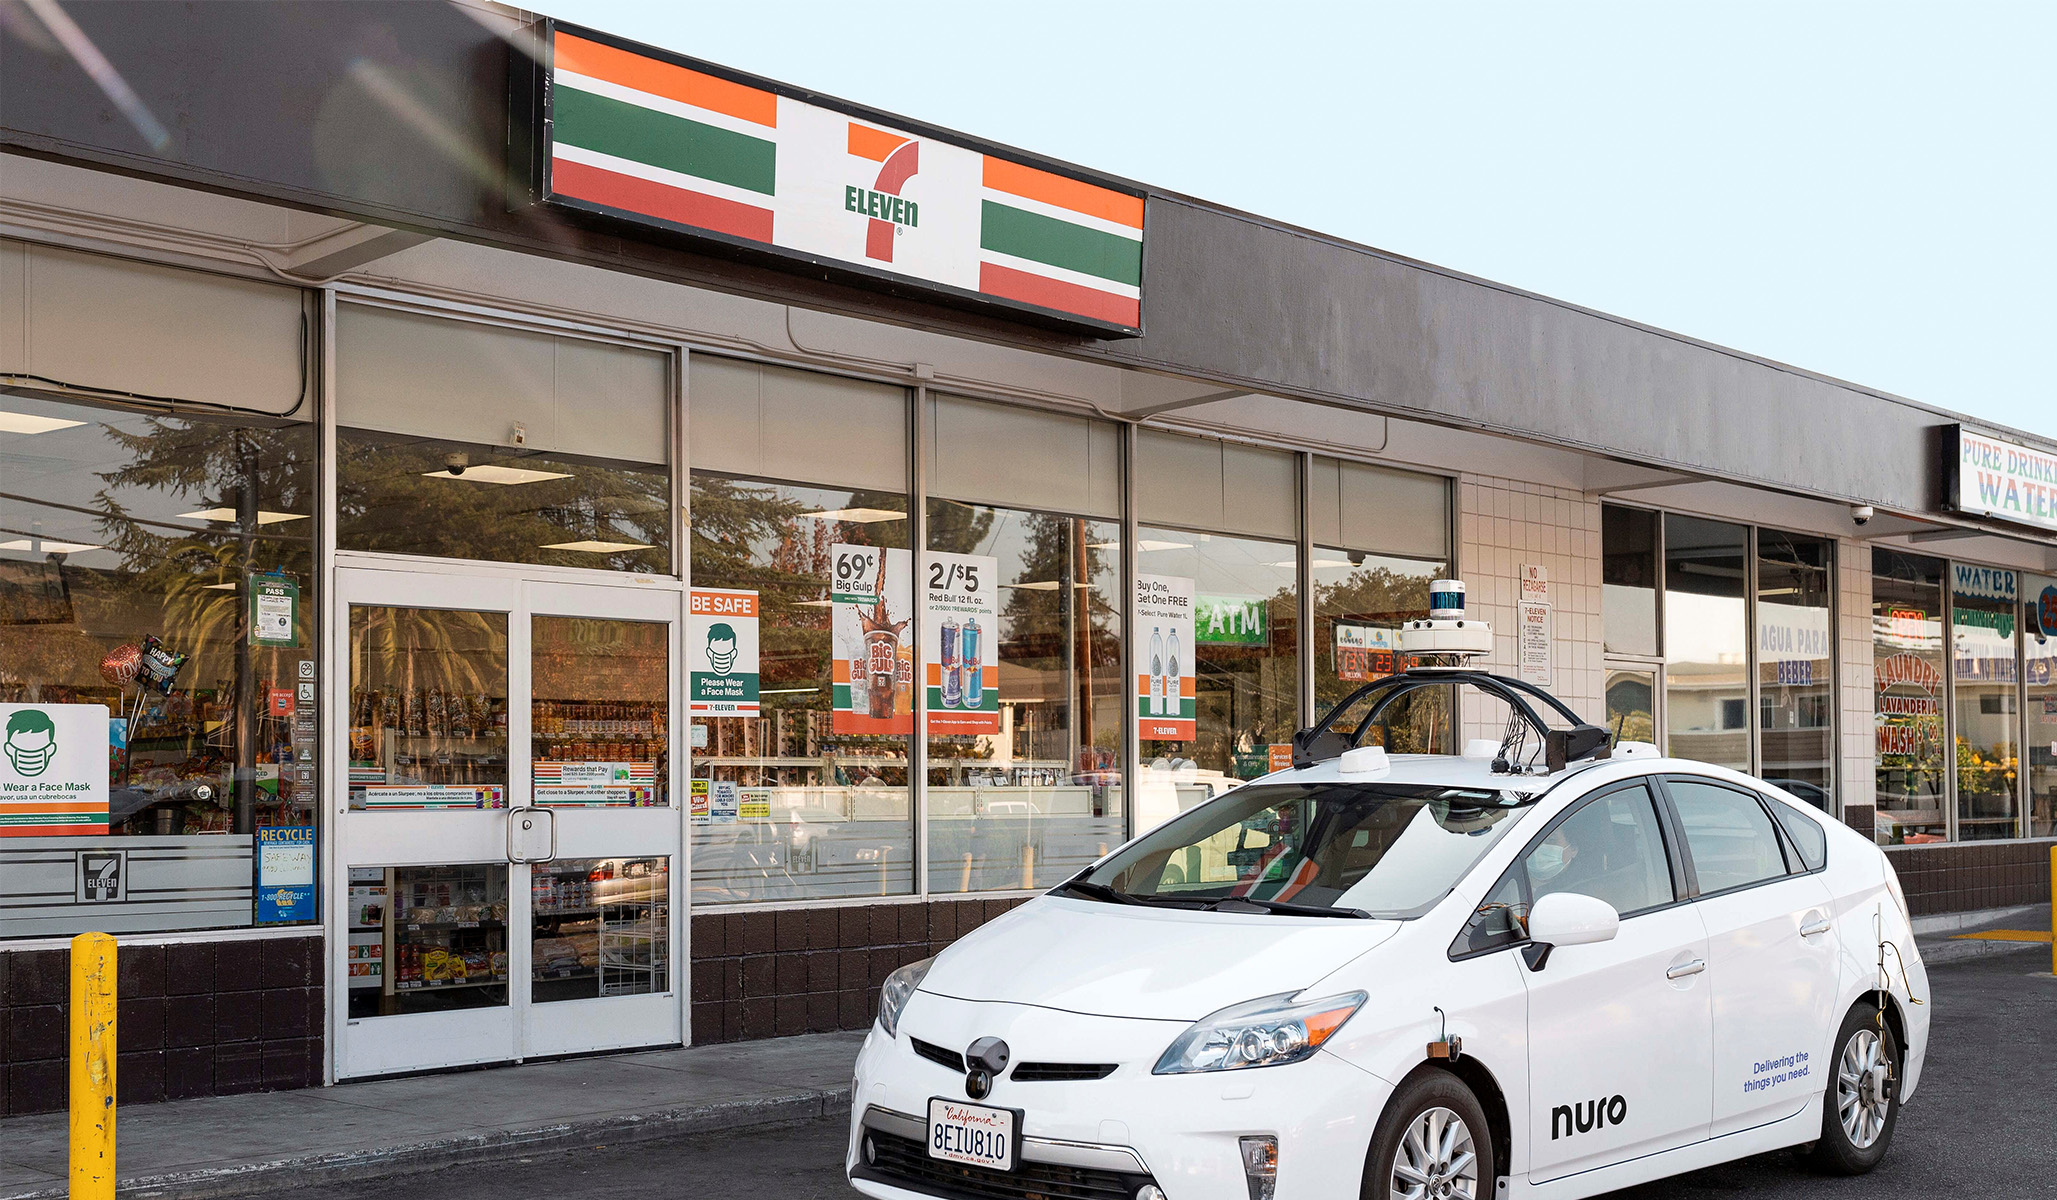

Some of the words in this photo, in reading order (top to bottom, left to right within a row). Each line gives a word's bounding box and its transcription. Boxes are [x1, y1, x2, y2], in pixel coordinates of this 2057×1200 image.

[848, 122, 918, 263] 7
[1963, 438, 2002, 471] PURE
[836, 553, 874, 580] 69¢
[1529, 566, 1538, 579] NO
[929, 562, 979, 592] 2/$5
[1523, 579, 1546, 593] REZAGARSE
[1956, 565, 2016, 594] WATER
[836, 580, 850, 592] Big
[852, 580, 872, 594] Gulp
[1138, 580, 1151, 592] Buy
[1152, 581, 1169, 593] One,
[692, 596, 711, 611] BE
[714, 597, 751, 614] SAFE
[929, 592, 942, 602] Red
[1138, 593, 1151, 604] Get
[1152, 594, 1166, 605] One
[1168, 596, 1188, 606] FREE
[1157, 610, 1168, 618] Pure
[1208, 604, 1260, 635] ATM
[1524, 607, 1546, 616] 7-ELEVEN
[1892, 610, 1924, 640] OPEN
[1761, 624, 1792, 652] AGUA
[1798, 628, 1828, 656] PARA
[150, 647, 174, 665] HAPPY
[869, 658, 894, 672] GULP
[1345, 653, 1364, 670] 137
[1376, 654, 1391, 672] 23
[141, 665, 150, 676] TO
[150, 670, 163, 682] YOU
[1778, 659, 1812, 686] BEBER
[1875, 653, 1940, 697] LAUNDRY
[701, 678, 724, 686] Please
[707, 688, 723, 696] Face
[1879, 696, 1938, 715] LAVANDERIA
[1879, 725, 1915, 755] WASH
[1917, 721, 1923, 744] $
[3, 783, 29, 791] Wear
[39, 783, 62, 791] Face
[65, 782, 90, 791] Mask
[261, 829, 312, 841] RECYCLE
[1754, 1055, 1794, 1074] Delivering
[1796, 1051, 1808, 1063] the
[1744, 1077, 1770, 1092] things
[1772, 1073, 1787, 1087] you
[1788, 1065, 1810, 1080] need.
[946, 1106, 996, 1126] California
[1552, 1095, 1626, 1140] nuro
[934, 1123, 1005, 1160] 8EIU810
[949, 1153, 990, 1164] dmv.ca.gov
